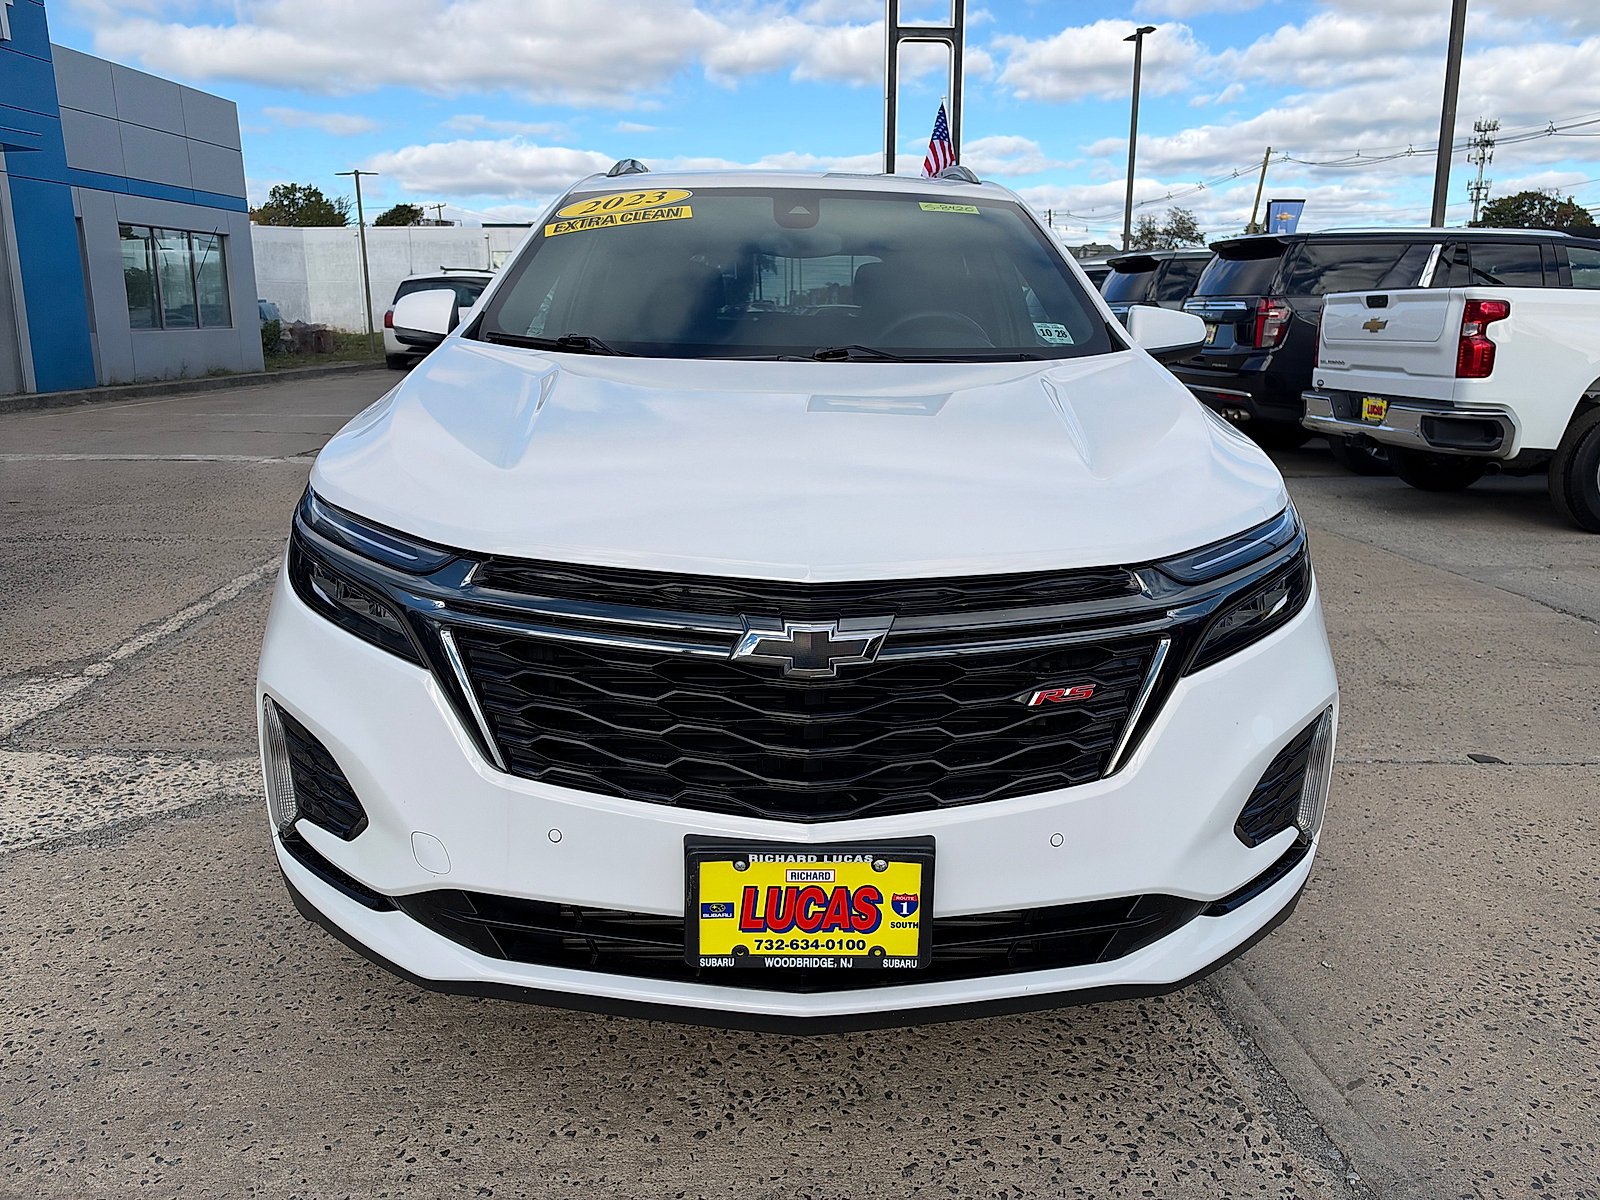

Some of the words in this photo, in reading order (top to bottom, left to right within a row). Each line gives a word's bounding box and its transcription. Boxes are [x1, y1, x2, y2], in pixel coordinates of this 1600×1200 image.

[579, 191, 668, 215] 2023
[552, 214, 616, 234] EXTRA
[620, 207, 683, 223] CLEAN
[1040, 329, 1053, 337] 10
[1055, 330, 1068, 338] 28
[1027, 684, 1096, 706] RS
[748, 854, 817, 863] RICHARD
[824, 854, 873, 863] LUCAS
[790, 872, 831, 881] RICHARD
[739, 885, 883, 934] LUCAS
[900, 901, 909, 915] 1
[890, 921, 919, 929] SOUTH
[754, 939, 866, 951] 732-634-0100
[700, 958, 735, 967] SUBARU
[764, 957, 838, 968] WOODBRIDGE,
[840, 957, 853, 968] NJ
[882, 958, 918, 968] SUBARU
